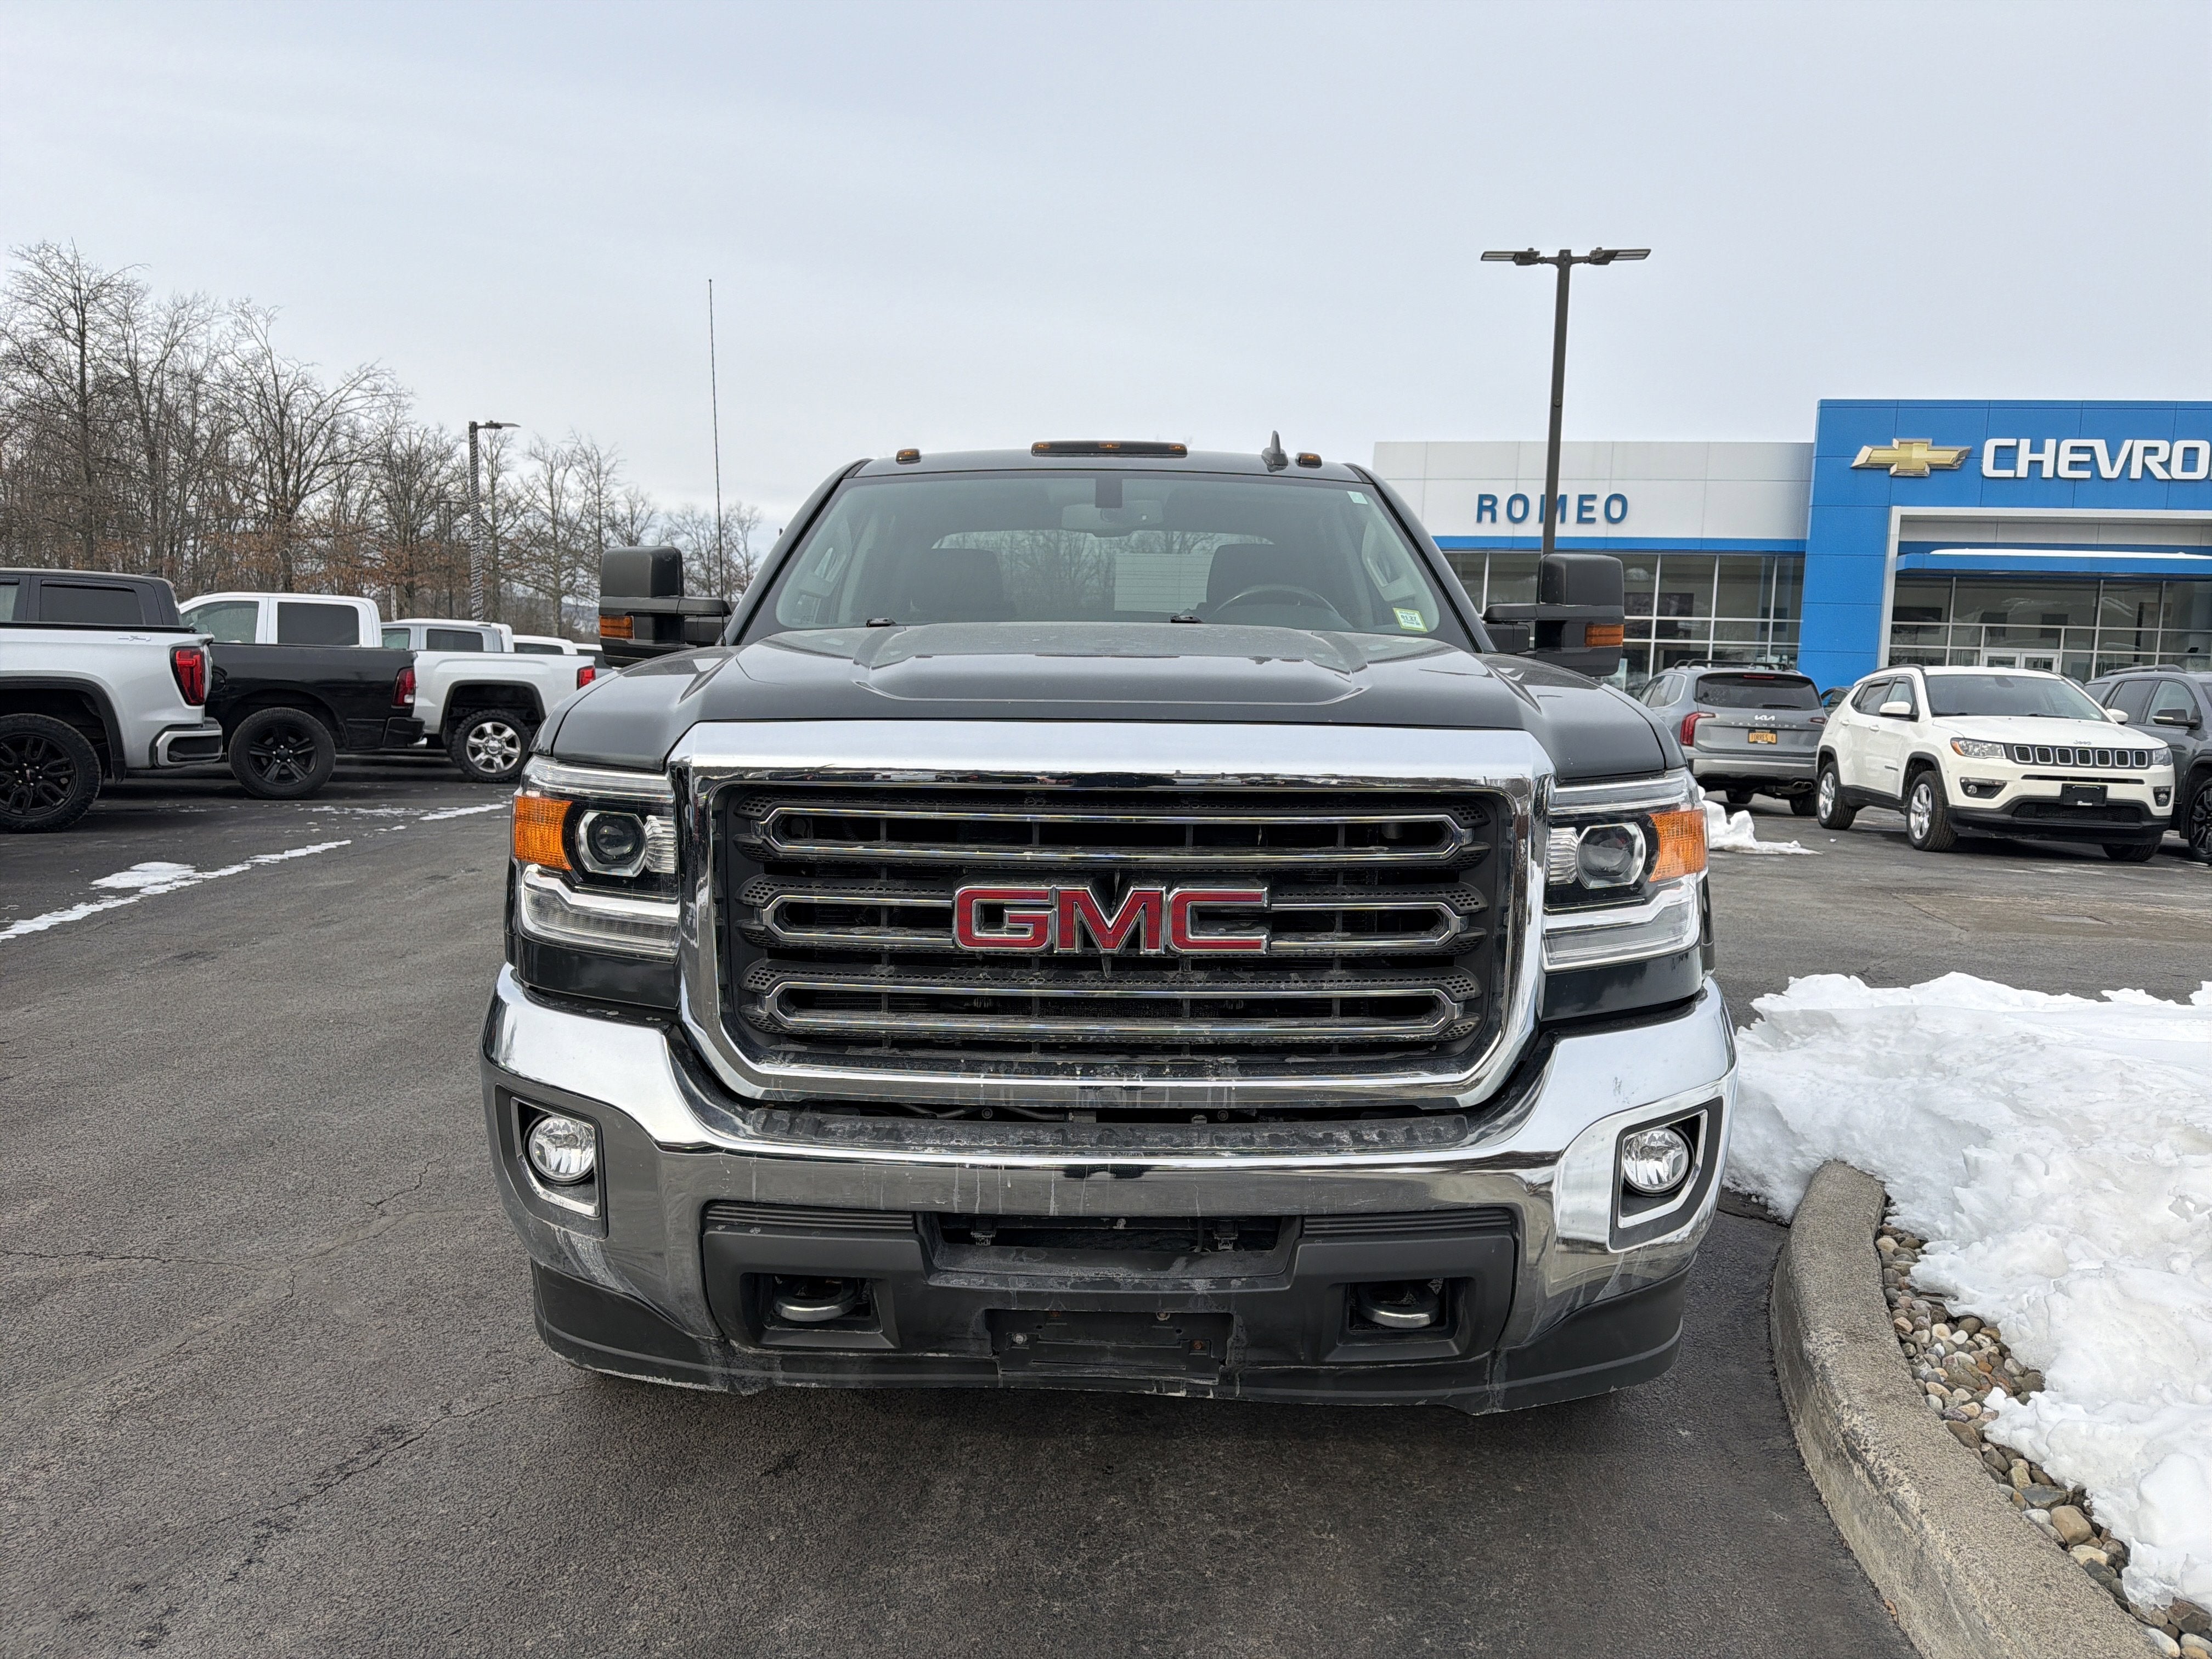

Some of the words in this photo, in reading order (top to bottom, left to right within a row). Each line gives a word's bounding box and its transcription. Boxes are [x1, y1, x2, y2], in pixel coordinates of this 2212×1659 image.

[1982, 438, 2212, 480] CHEVRO
[1476, 493, 1629, 524] ROMEO
[953, 884, 1268, 955] GMC
